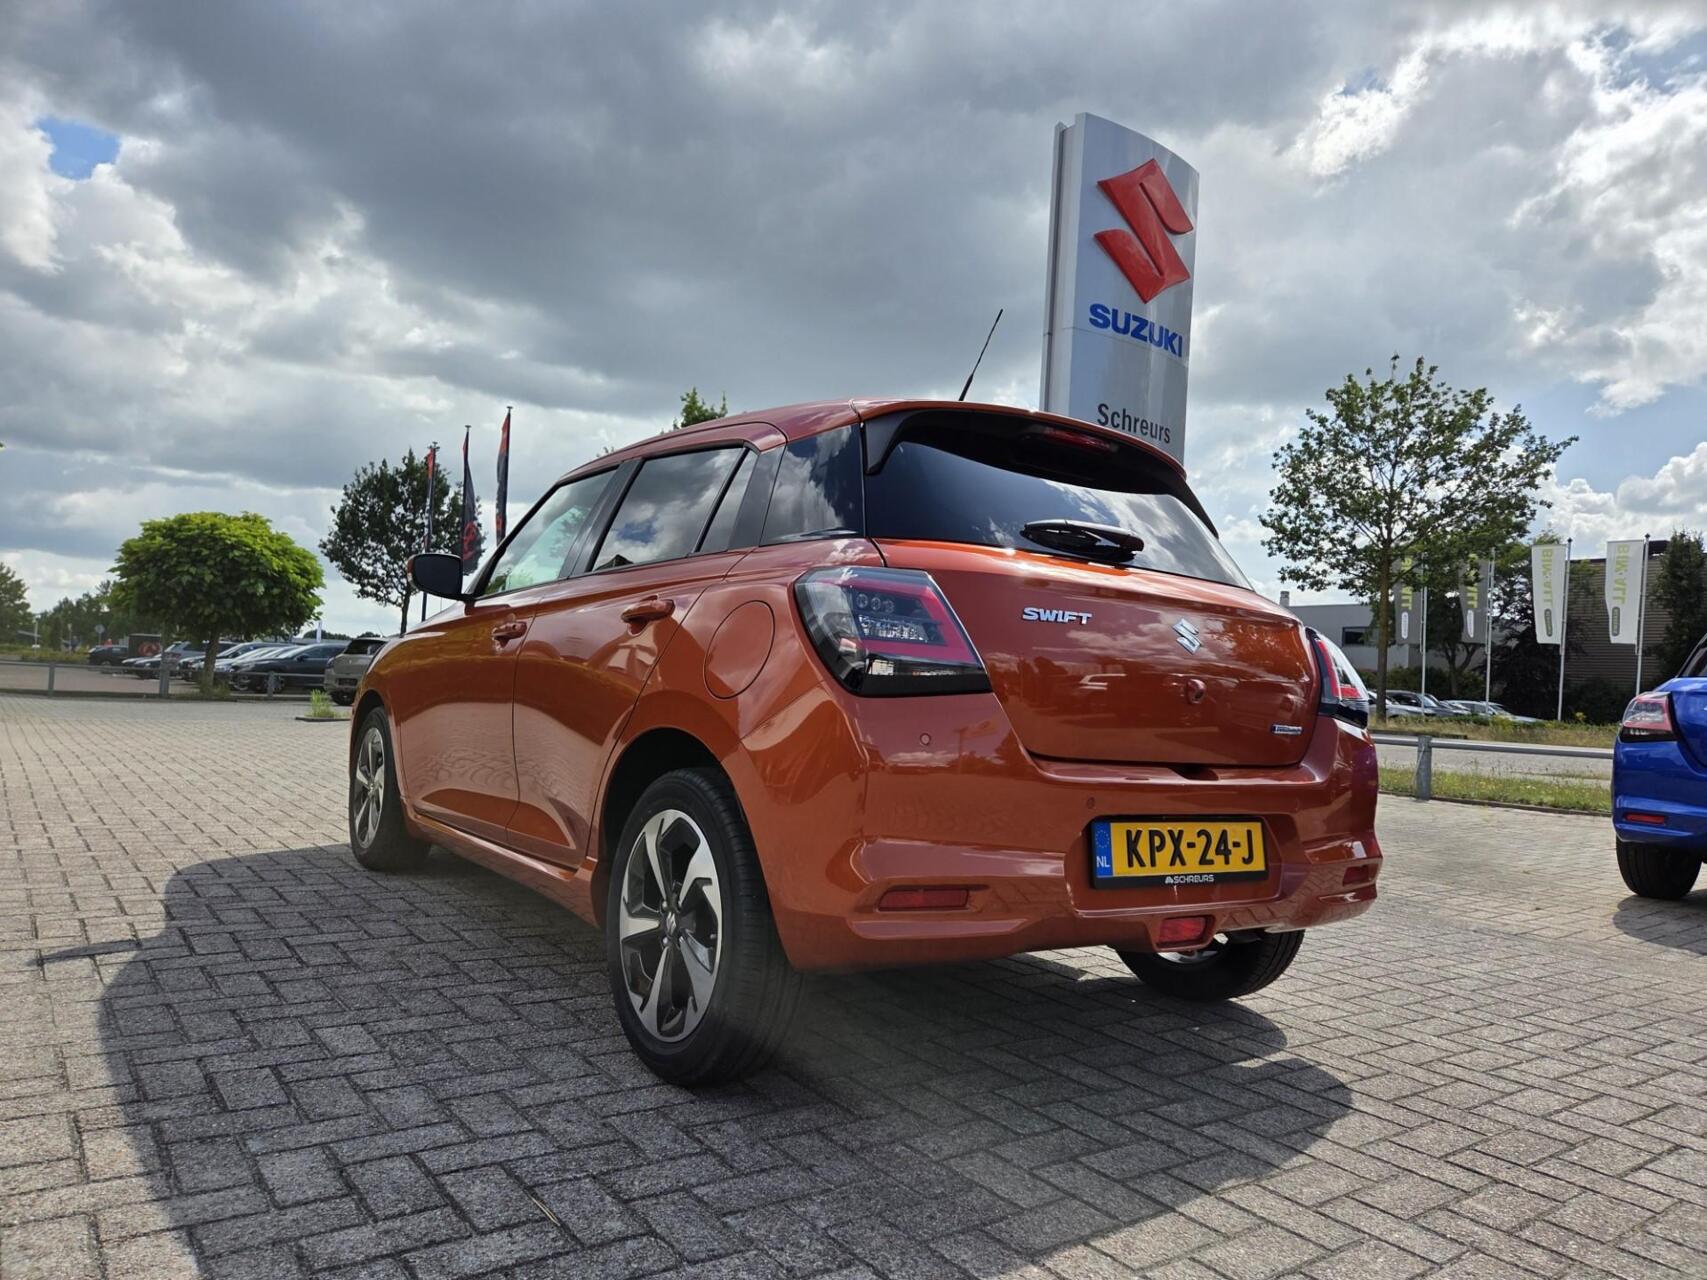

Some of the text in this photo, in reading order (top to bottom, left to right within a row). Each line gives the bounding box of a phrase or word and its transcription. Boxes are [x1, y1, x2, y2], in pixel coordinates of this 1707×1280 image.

[1089, 303, 1182, 357] SUZUKI
[1097, 403, 1170, 443] Schreurs
[1022, 607, 1092, 625] SWIFT
[1096, 855, 1111, 868] NL
[1126, 829, 1255, 868] KPX-24-J
[1173, 874, 1215, 884] SCHREURS
